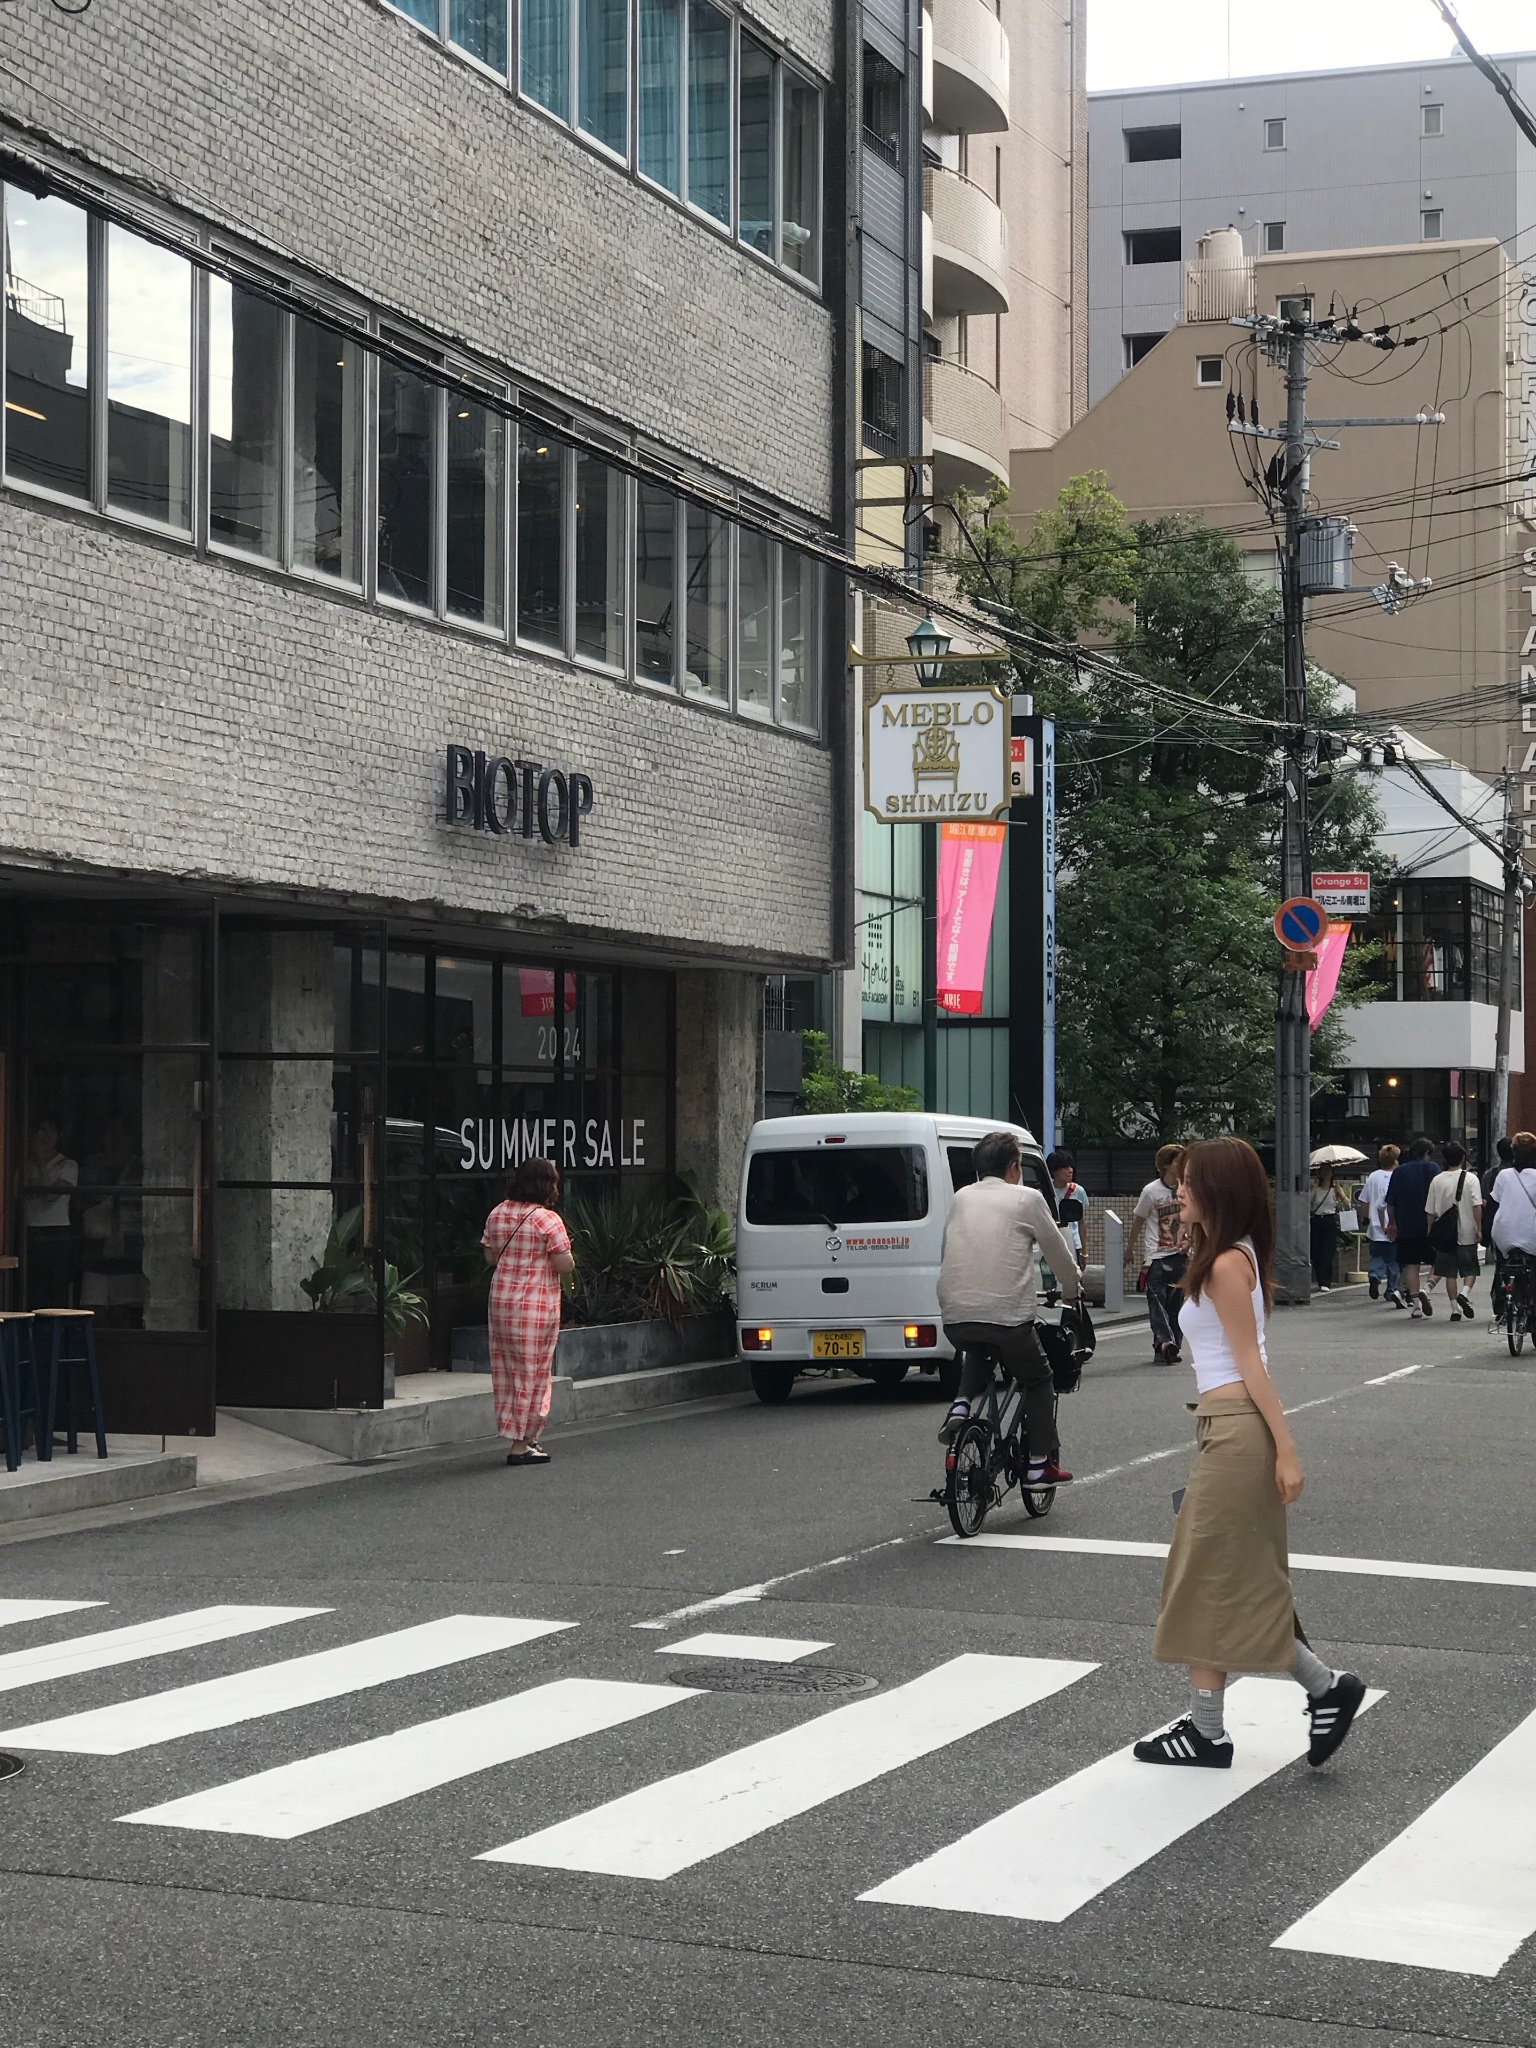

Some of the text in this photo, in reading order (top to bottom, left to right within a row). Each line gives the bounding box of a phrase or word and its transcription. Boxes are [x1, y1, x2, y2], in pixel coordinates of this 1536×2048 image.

[882, 701, 995, 728] MEBLO
[446, 744, 594, 848] BIOTOP
[886, 793, 988, 813] SHIMIZU
[1045, 743, 1053, 1005] MIRABELL NORTH
[1315, 877, 1366, 887] Orange St.
[861, 952, 889, 990] Horie
[538, 1026, 581, 1061] 2024
[460, 1117, 645, 1170] SUMMER SALE
[751, 1281, 778, 1289] SCRUM
[824, 1341, 860, 1356] 70-15
